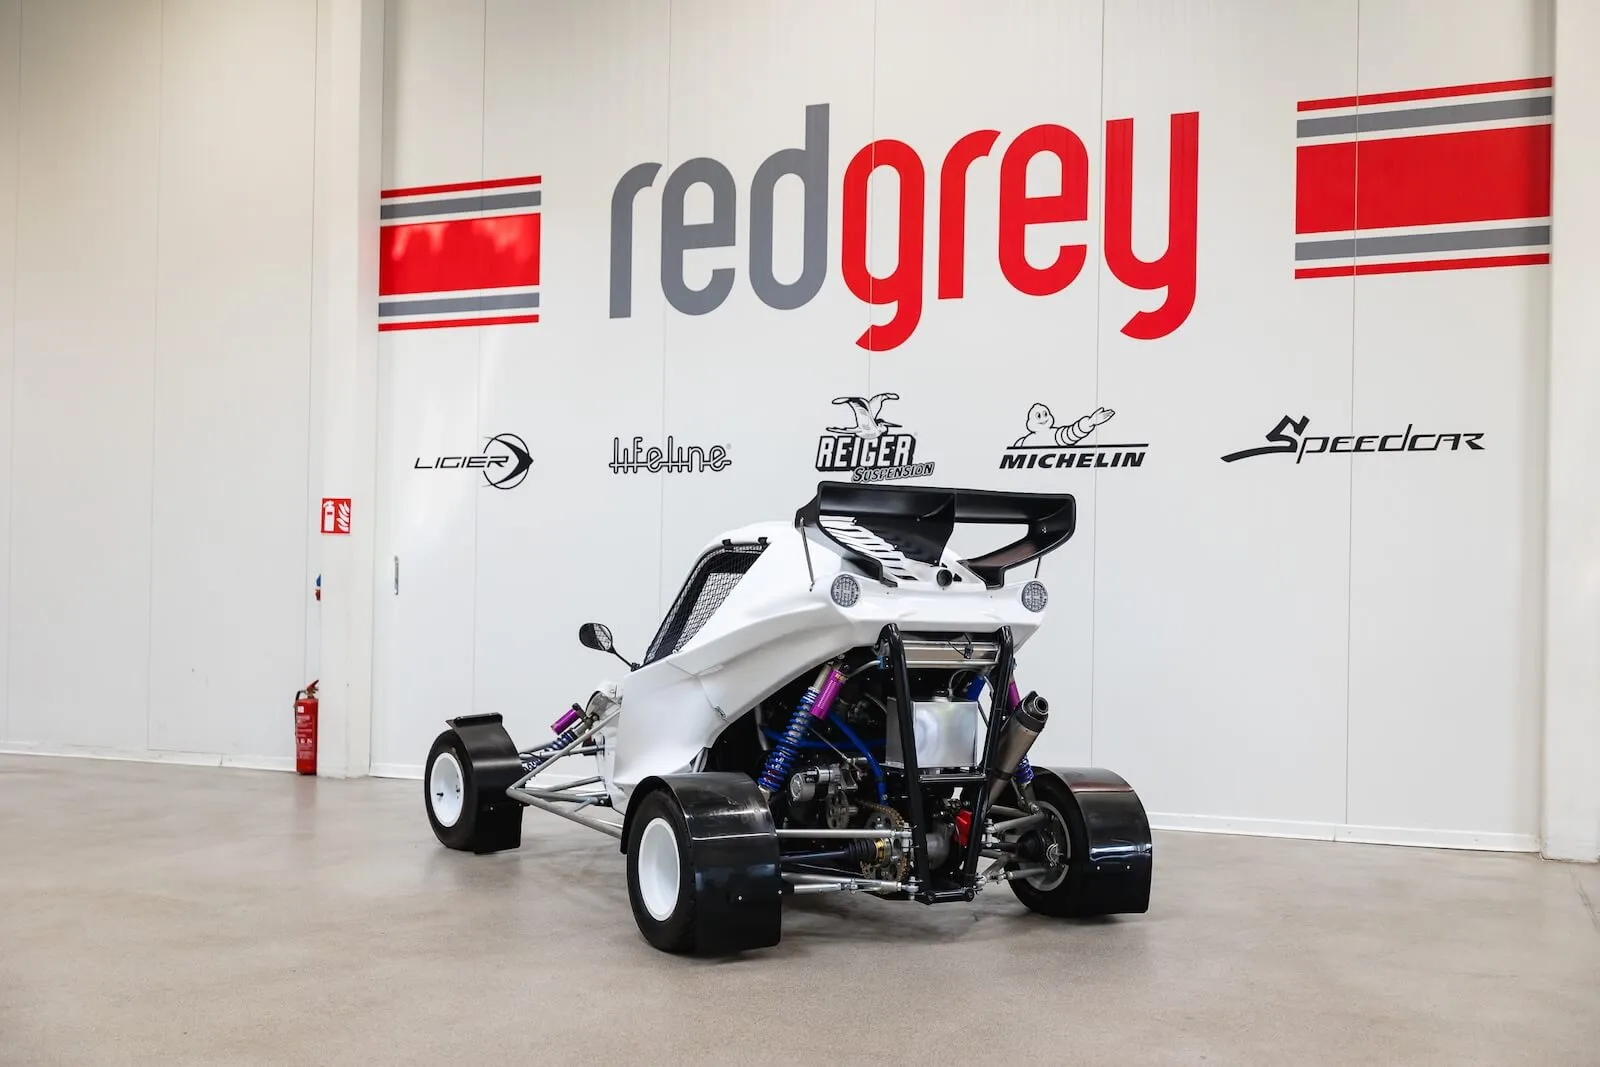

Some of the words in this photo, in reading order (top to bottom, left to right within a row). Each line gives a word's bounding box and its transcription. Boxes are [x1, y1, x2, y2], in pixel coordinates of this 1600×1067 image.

[610, 104, 1199, 352] redgrey
[414, 456, 509, 469] LIGIER
[816, 434, 917, 471] REIGER
[999, 452, 1146, 469] MICHELIN
[852, 462, 935, 482] SUSPENSION
